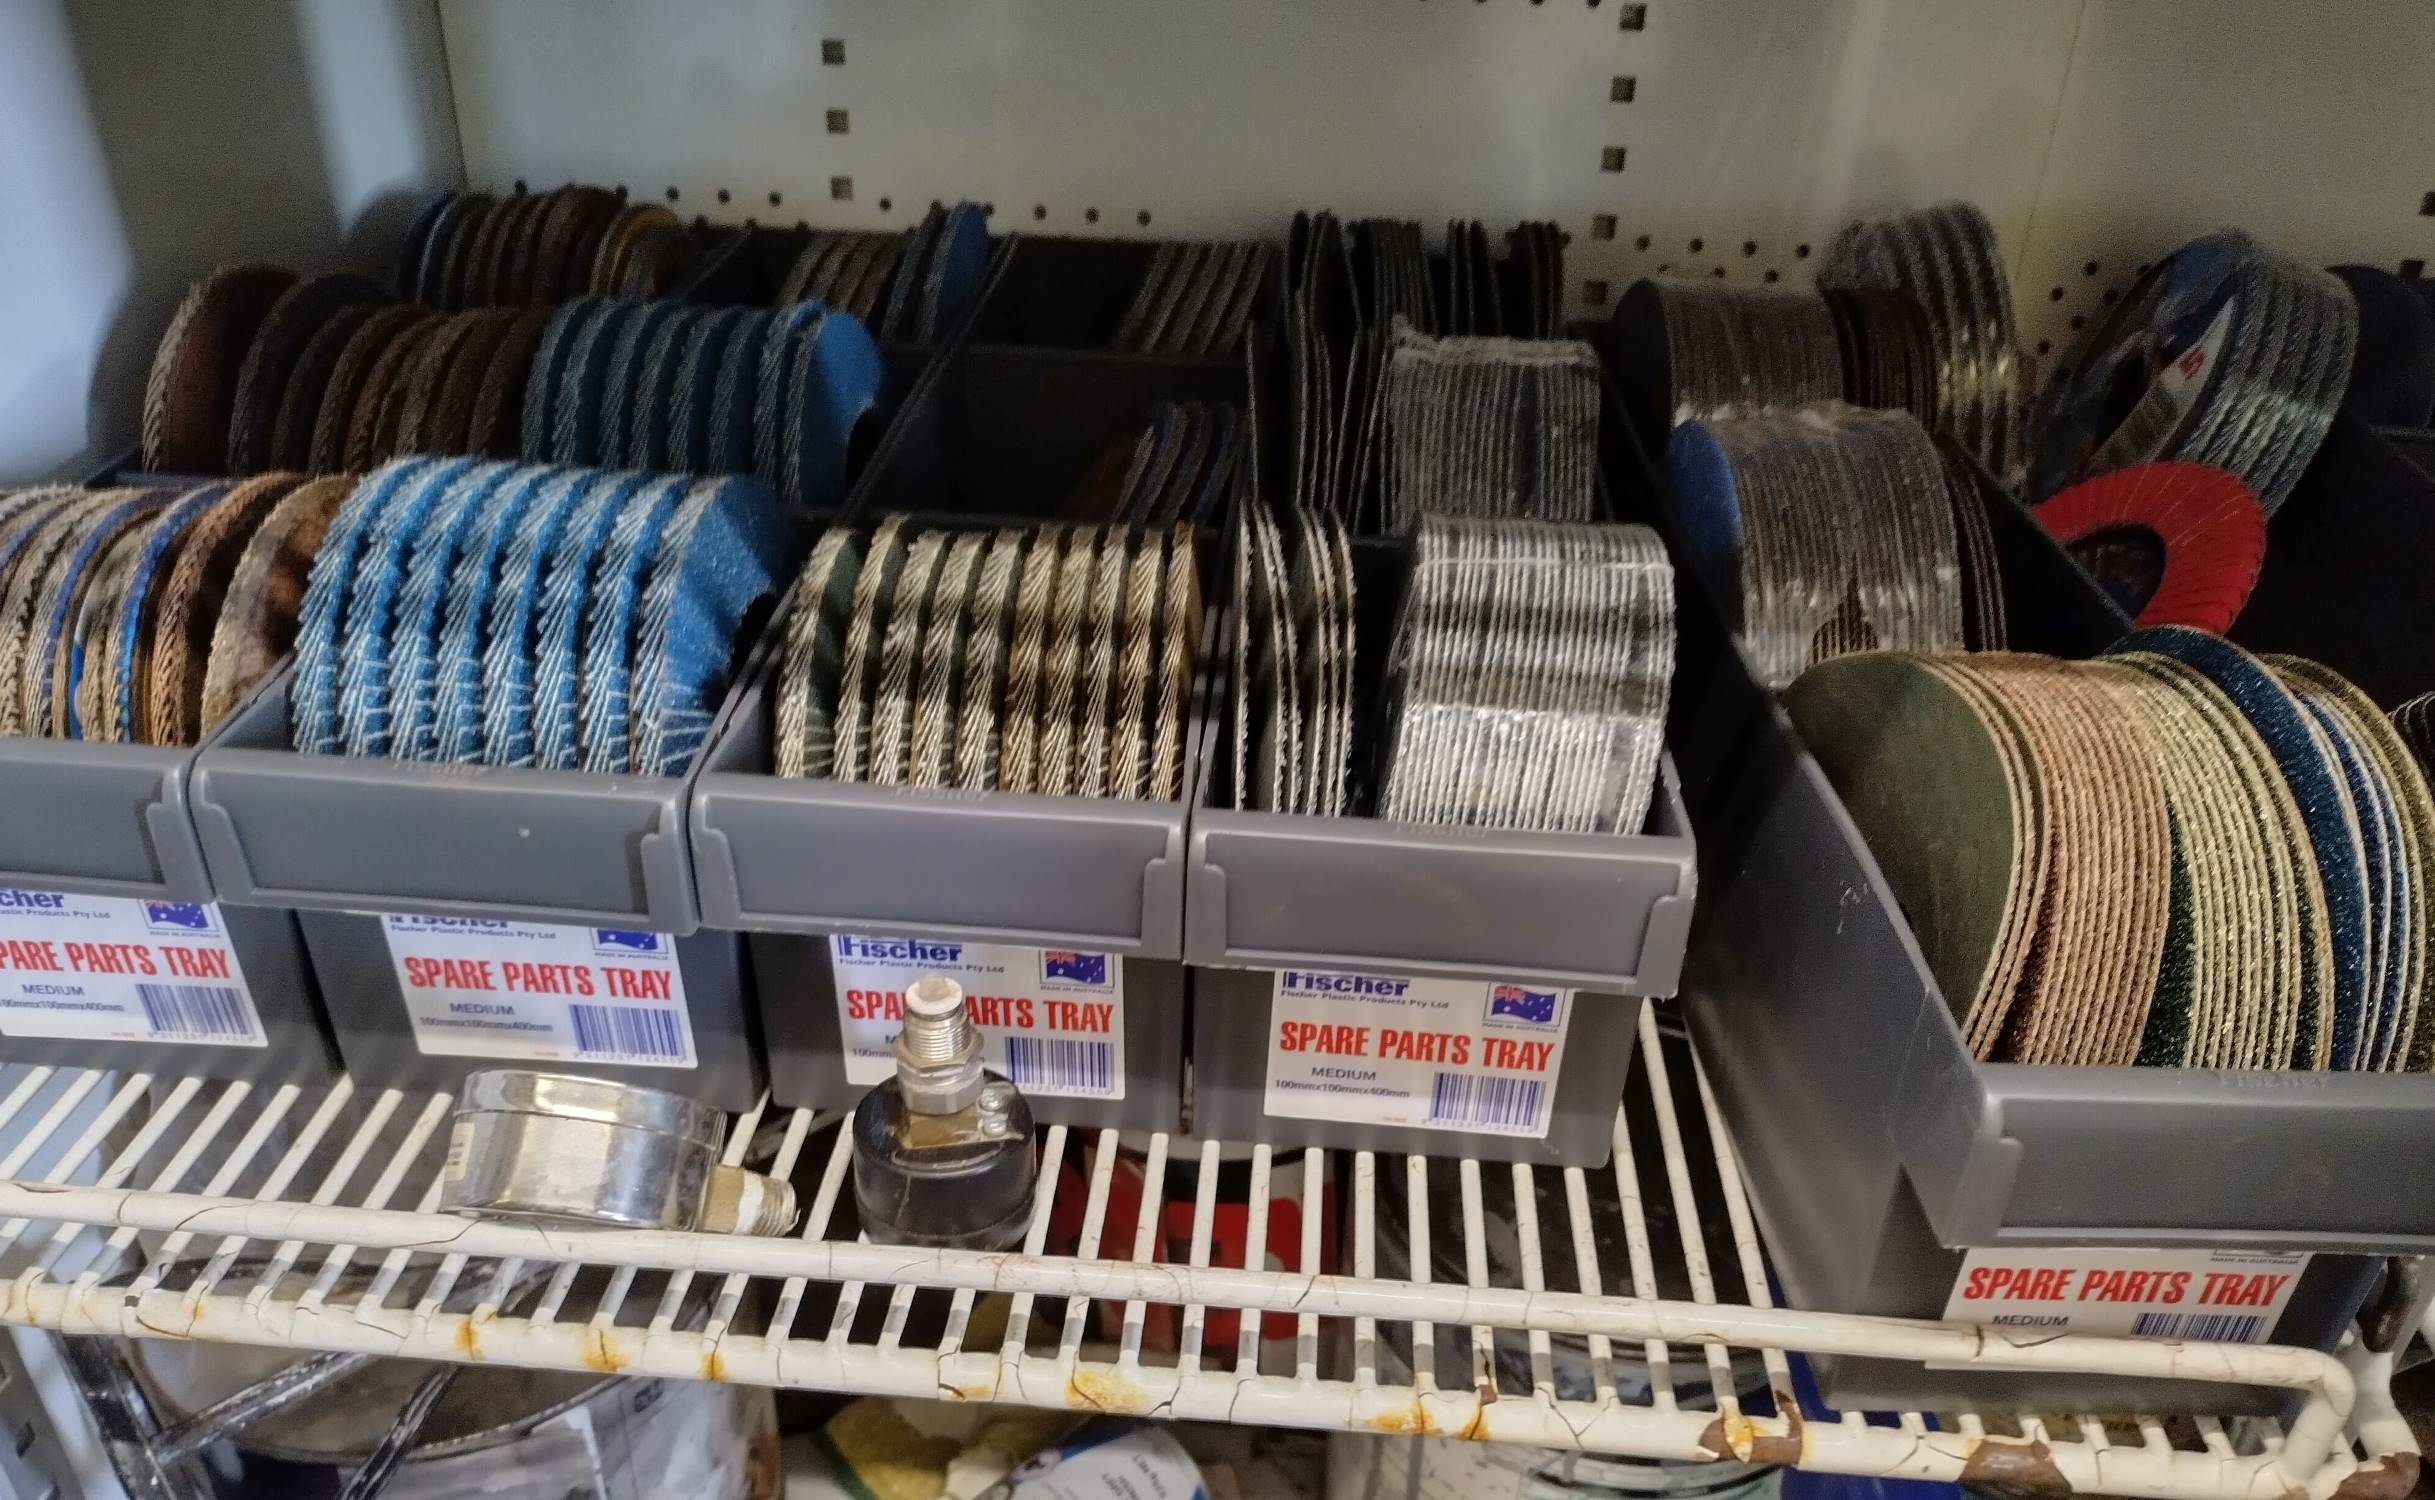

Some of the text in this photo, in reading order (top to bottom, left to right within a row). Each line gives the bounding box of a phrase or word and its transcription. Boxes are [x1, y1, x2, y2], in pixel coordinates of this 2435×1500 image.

[0, 890, 64, 908] cher
[517, 930, 535, 940] Pty
[538, 931, 557, 939] Ltd
[838, 935, 963, 961] Fischer
[0, 940, 231, 979] PARE PARTS TRAY
[966, 964, 984, 973] Pty
[404, 956, 672, 1001] SPARE PARTS TRAY
[1283, 971, 1410, 996] Fischer
[22, 984, 85, 996] MEDIUM
[450, 1002, 515, 1015] MEDIUM
[846, 989, 1114, 1034] SPA ARTS TRAY
[1410, 999, 1428, 1008] Pty
[1431, 1001, 1449, 1009] Ltd
[1280, 1020, 1555, 1072] SPARE PARTS TRAY
[1311, 1067, 1377, 1081] MEDIUM
[1963, 1267, 2291, 1307] SPARE PARTS TRAY
[1991, 1314, 2070, 1328] MEDIUM
